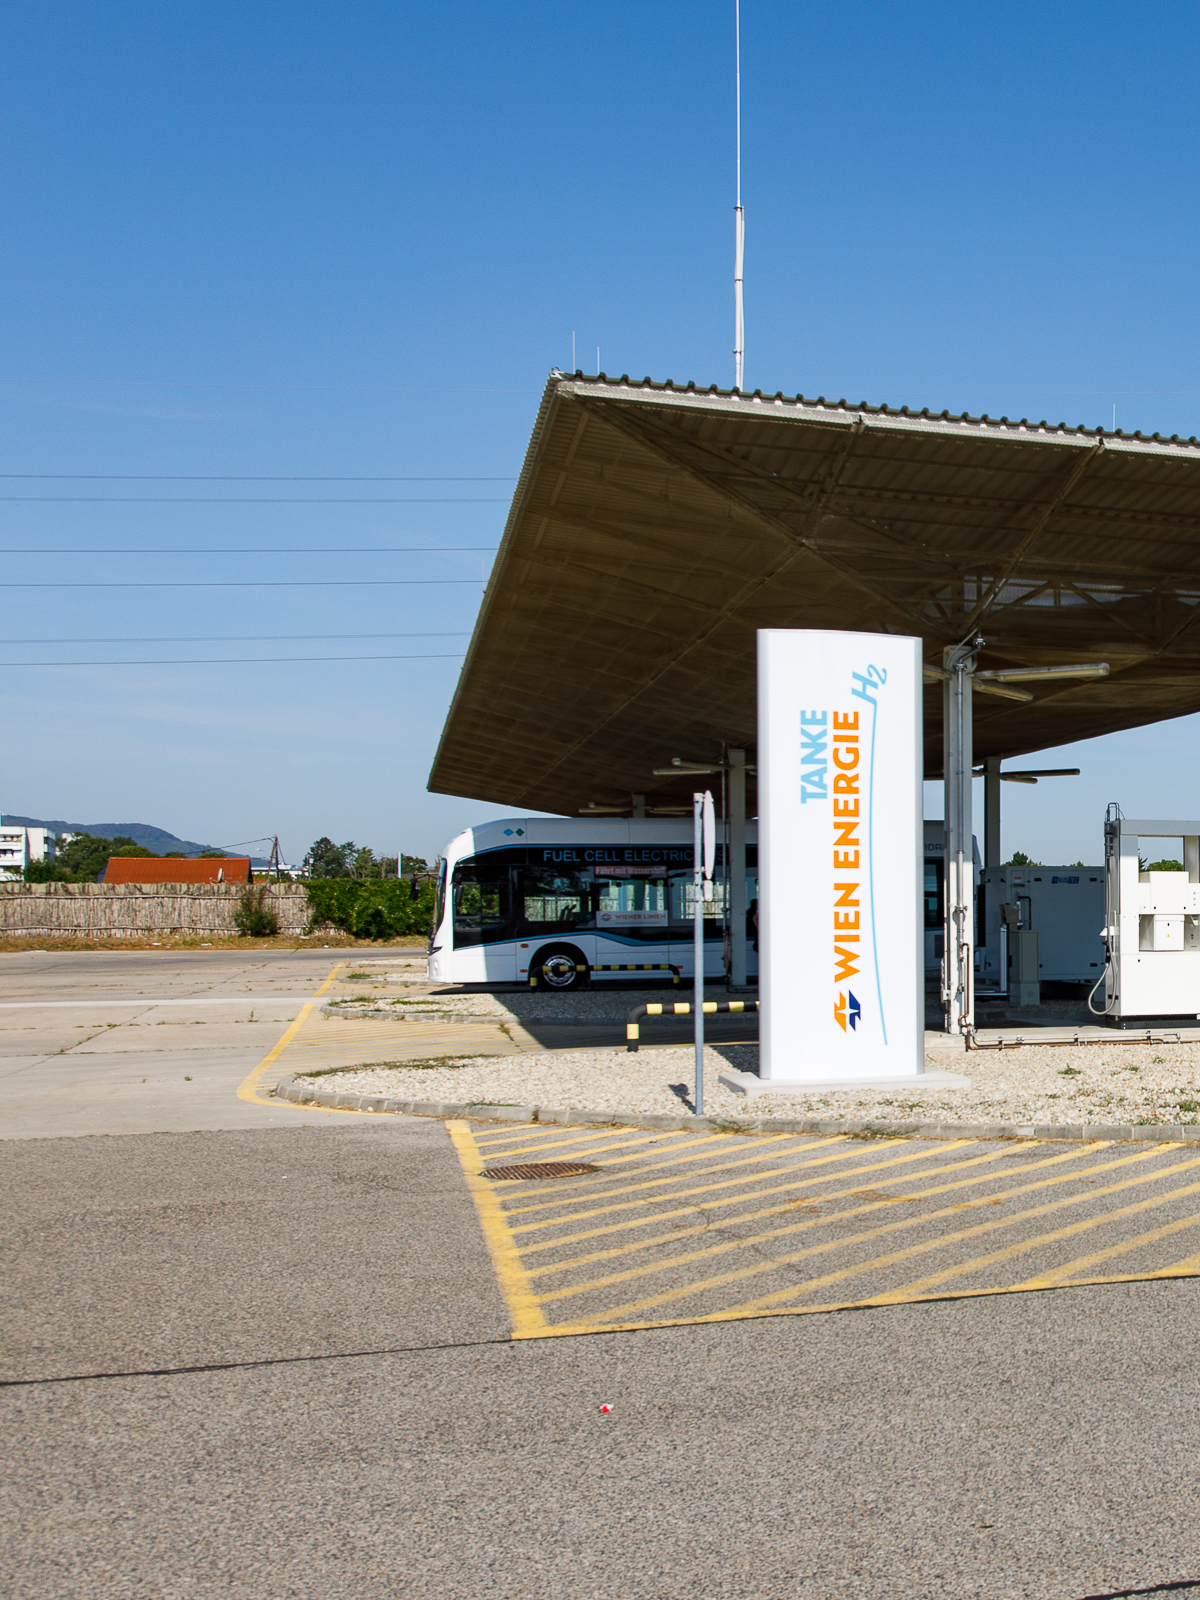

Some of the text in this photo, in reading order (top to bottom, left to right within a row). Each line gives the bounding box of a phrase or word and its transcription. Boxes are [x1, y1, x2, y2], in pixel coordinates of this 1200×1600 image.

[800, 710, 828, 804] TANKE
[543, 850, 581, 862] FUEL
[584, 850, 621, 862] CELL
[624, 850, 694, 862] ELECTRIC
[614, 866, 626, 875] mit
[832, 711, 861, 984] WIEN ENERGIE
